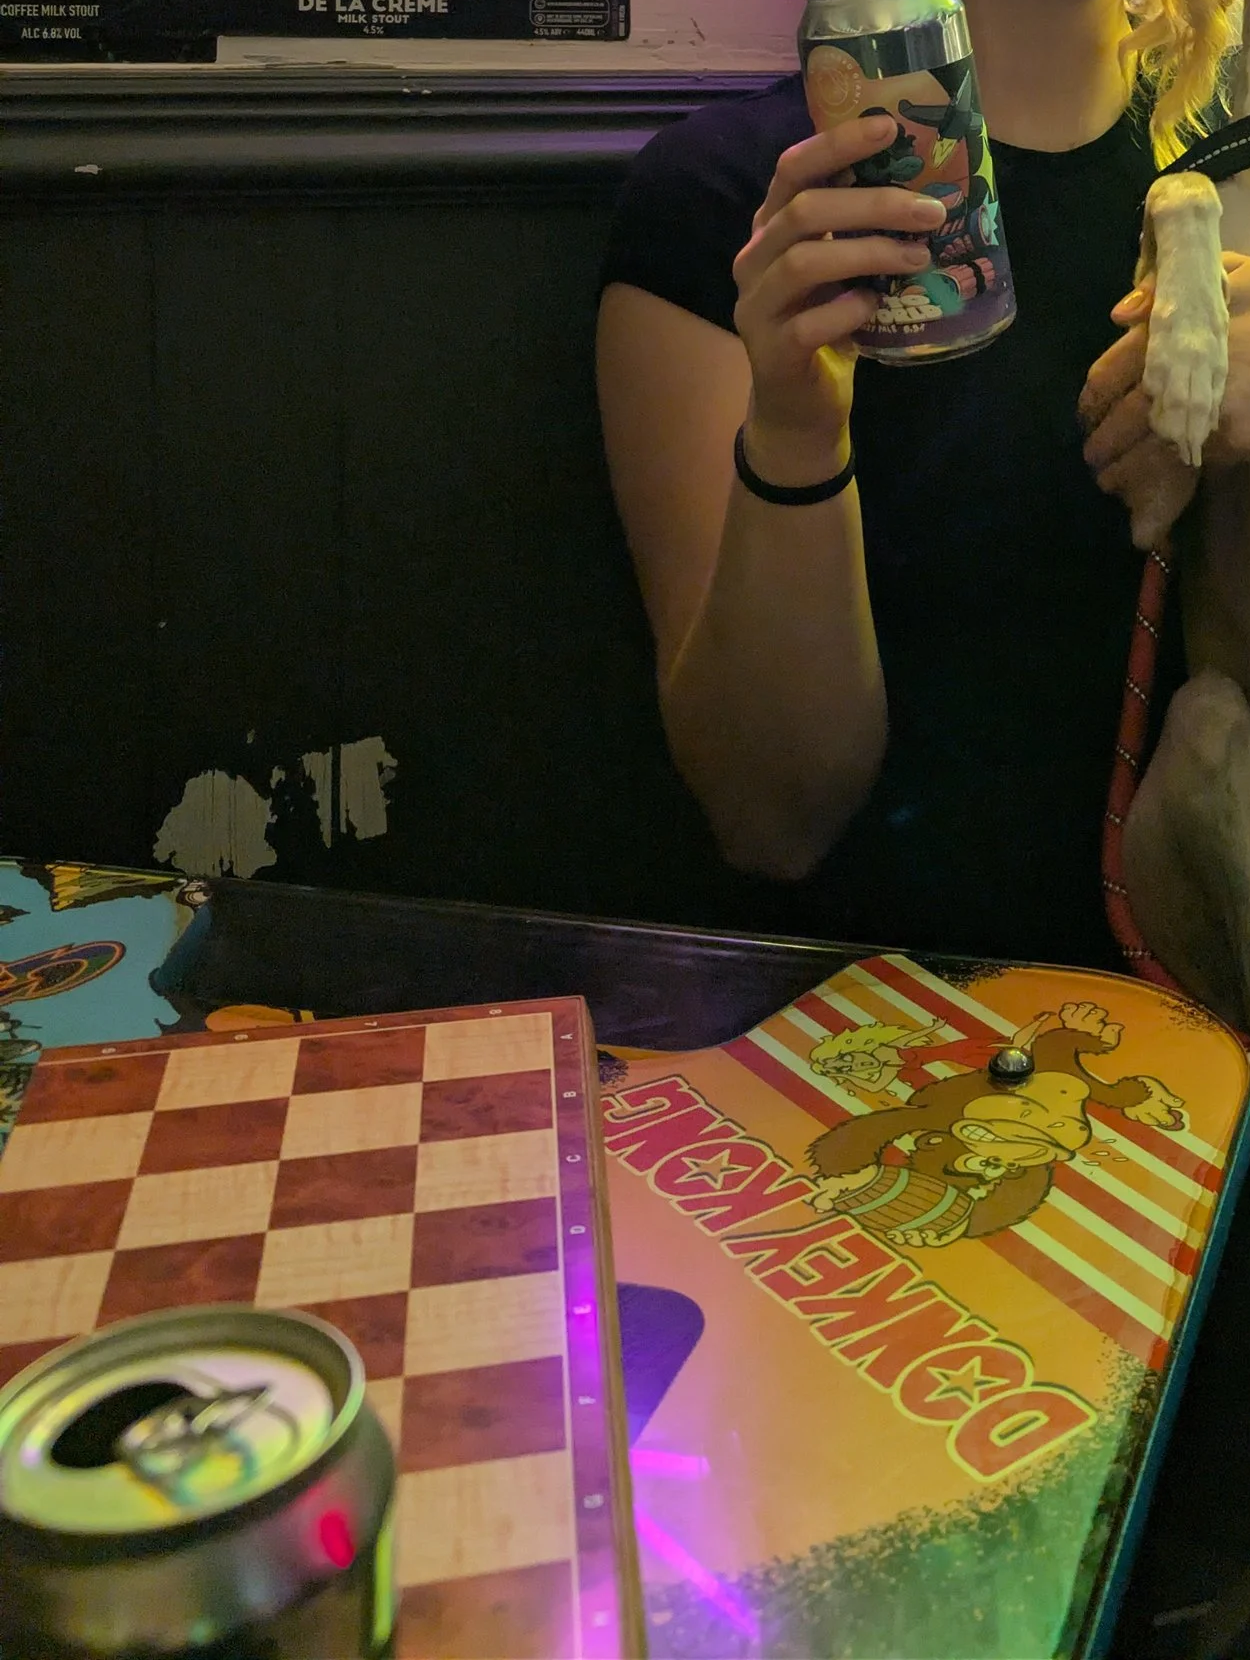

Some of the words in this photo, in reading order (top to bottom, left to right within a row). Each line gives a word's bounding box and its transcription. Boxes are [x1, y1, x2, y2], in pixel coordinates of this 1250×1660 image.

[0, 3, 39, 18] COFFEE
[40, 3, 67, 18] MILK
[69, 3, 101, 18] STOUT
[336, 13, 369, 25] MILK
[371, 14, 410, 26] STOUT
[20, 27, 41, 40] ALC
[41, 27, 63, 41] 6.8%
[64, 27, 83, 40] VOL
[362, 24, 385, 35] 4.5%
[600, 1073, 821, 1236] KONG
[719, 1211, 1101, 1484] DONKEY
